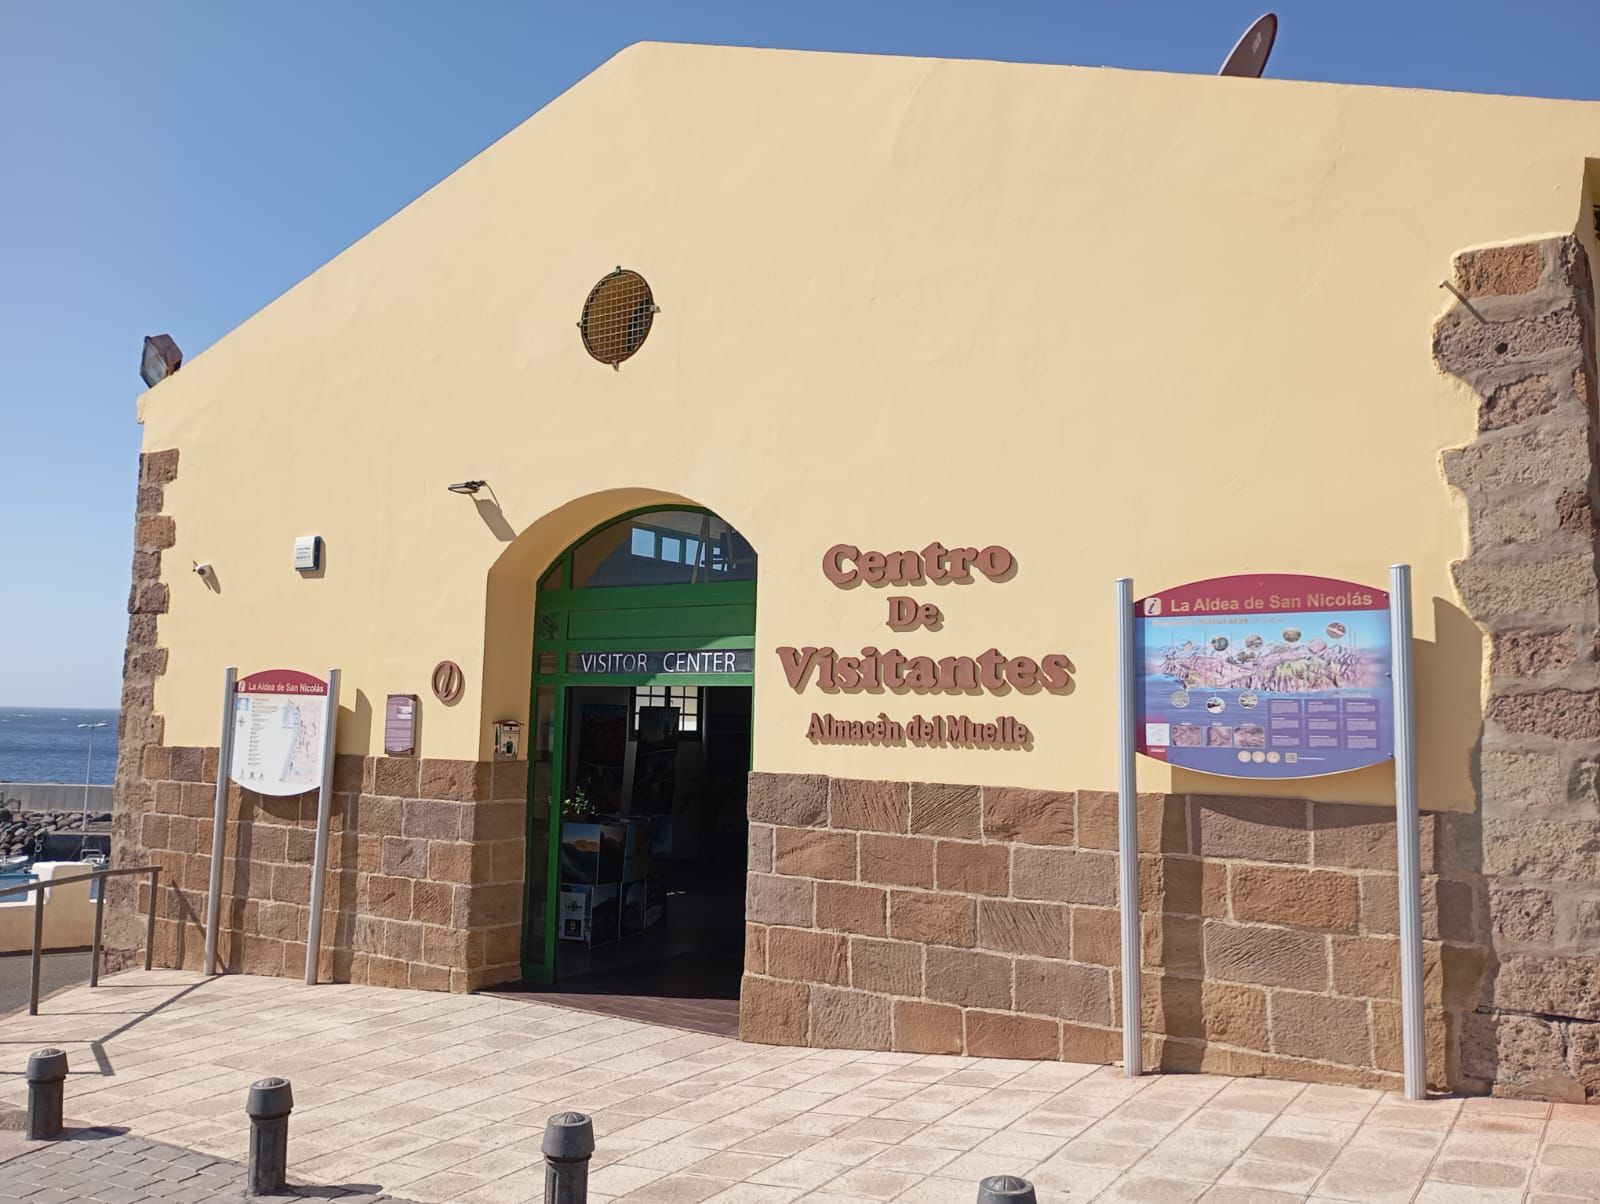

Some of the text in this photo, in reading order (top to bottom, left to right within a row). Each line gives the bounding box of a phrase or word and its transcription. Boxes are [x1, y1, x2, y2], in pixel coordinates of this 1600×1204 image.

[822, 541, 1014, 586] Centro
[886, 596, 940, 627] De
[1171, 600, 1189, 612] La
[1194, 598, 1239, 612] Aldea
[1244, 597, 1264, 610] de
[1269, 597, 1301, 610] San
[1307, 592, 1373, 609] Nicolás
[581, 652, 736, 673] VISITOR CENTER
[775, 646, 1073, 690] Visitantes
[248, 682, 256, 691] La
[257, 682, 275, 691] Aldea
[276, 683, 285, 691] de
[286, 683, 298, 692] San
[300, 683, 324, 693] Nicolás
[906, 714, 943, 743] del
[946, 715, 1028, 745] Muelle
